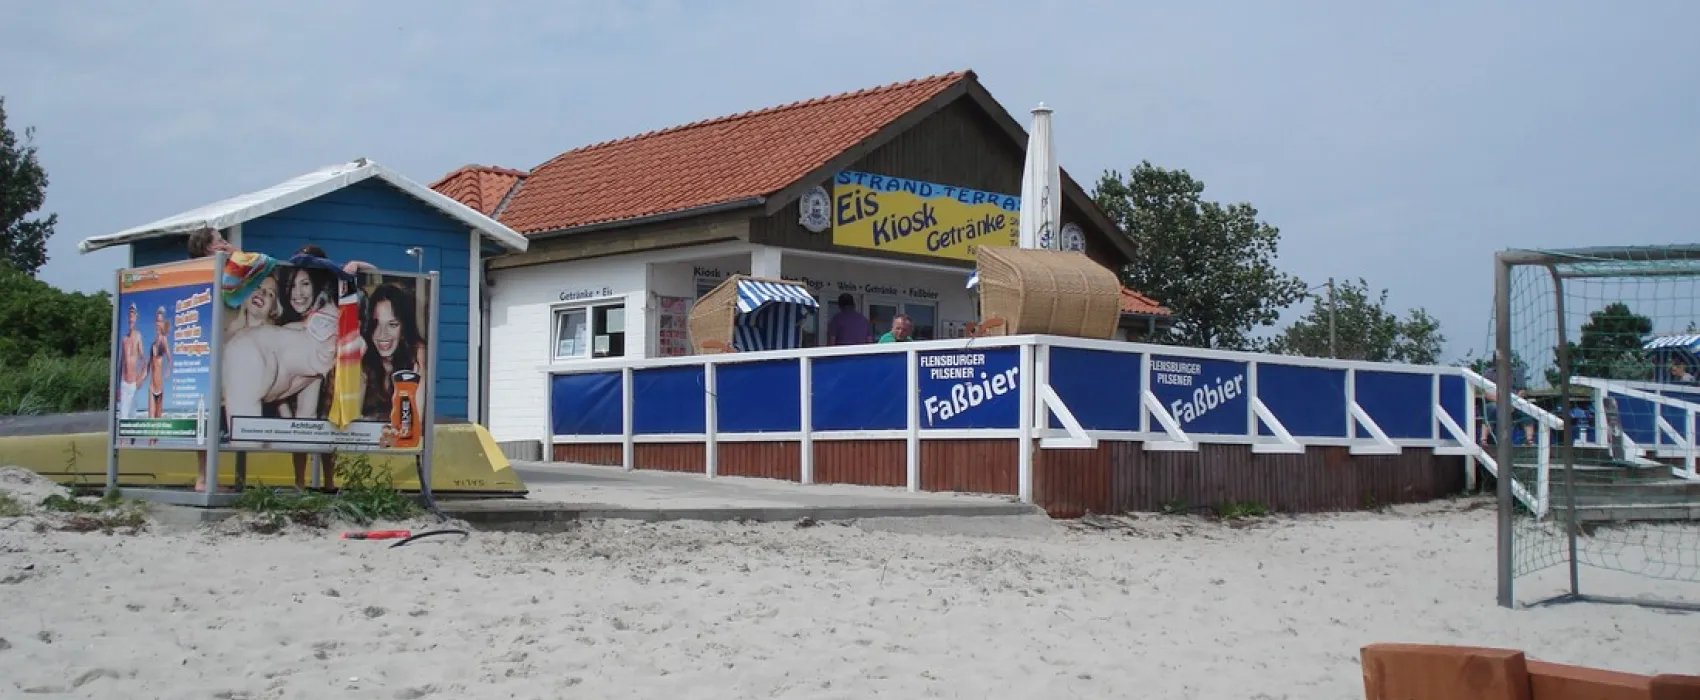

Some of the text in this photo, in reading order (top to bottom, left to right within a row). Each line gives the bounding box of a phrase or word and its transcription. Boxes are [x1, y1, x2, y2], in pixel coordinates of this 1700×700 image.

[837, 170, 1021, 211] STRAND-TERRA
[837, 189, 879, 226] Eis
[873, 203, 938, 246] Kiosk
[926, 213, 1006, 251] Getränke
[694, 266, 721, 278] Kiosk
[603, 287, 613, 297] Eis
[837, 282, 857, 292] Wein
[921, 354, 986, 367] FLENSBURGER
[1150, 360, 1201, 374] FLENSBURGER
[931, 367, 975, 380] PILSENER
[1157, 373, 1193, 386] PILSENER
[924, 366, 1019, 427] Faßbier
[1171, 374, 1243, 428] Faßbier
[291, 421, 324, 431] Achtung!
